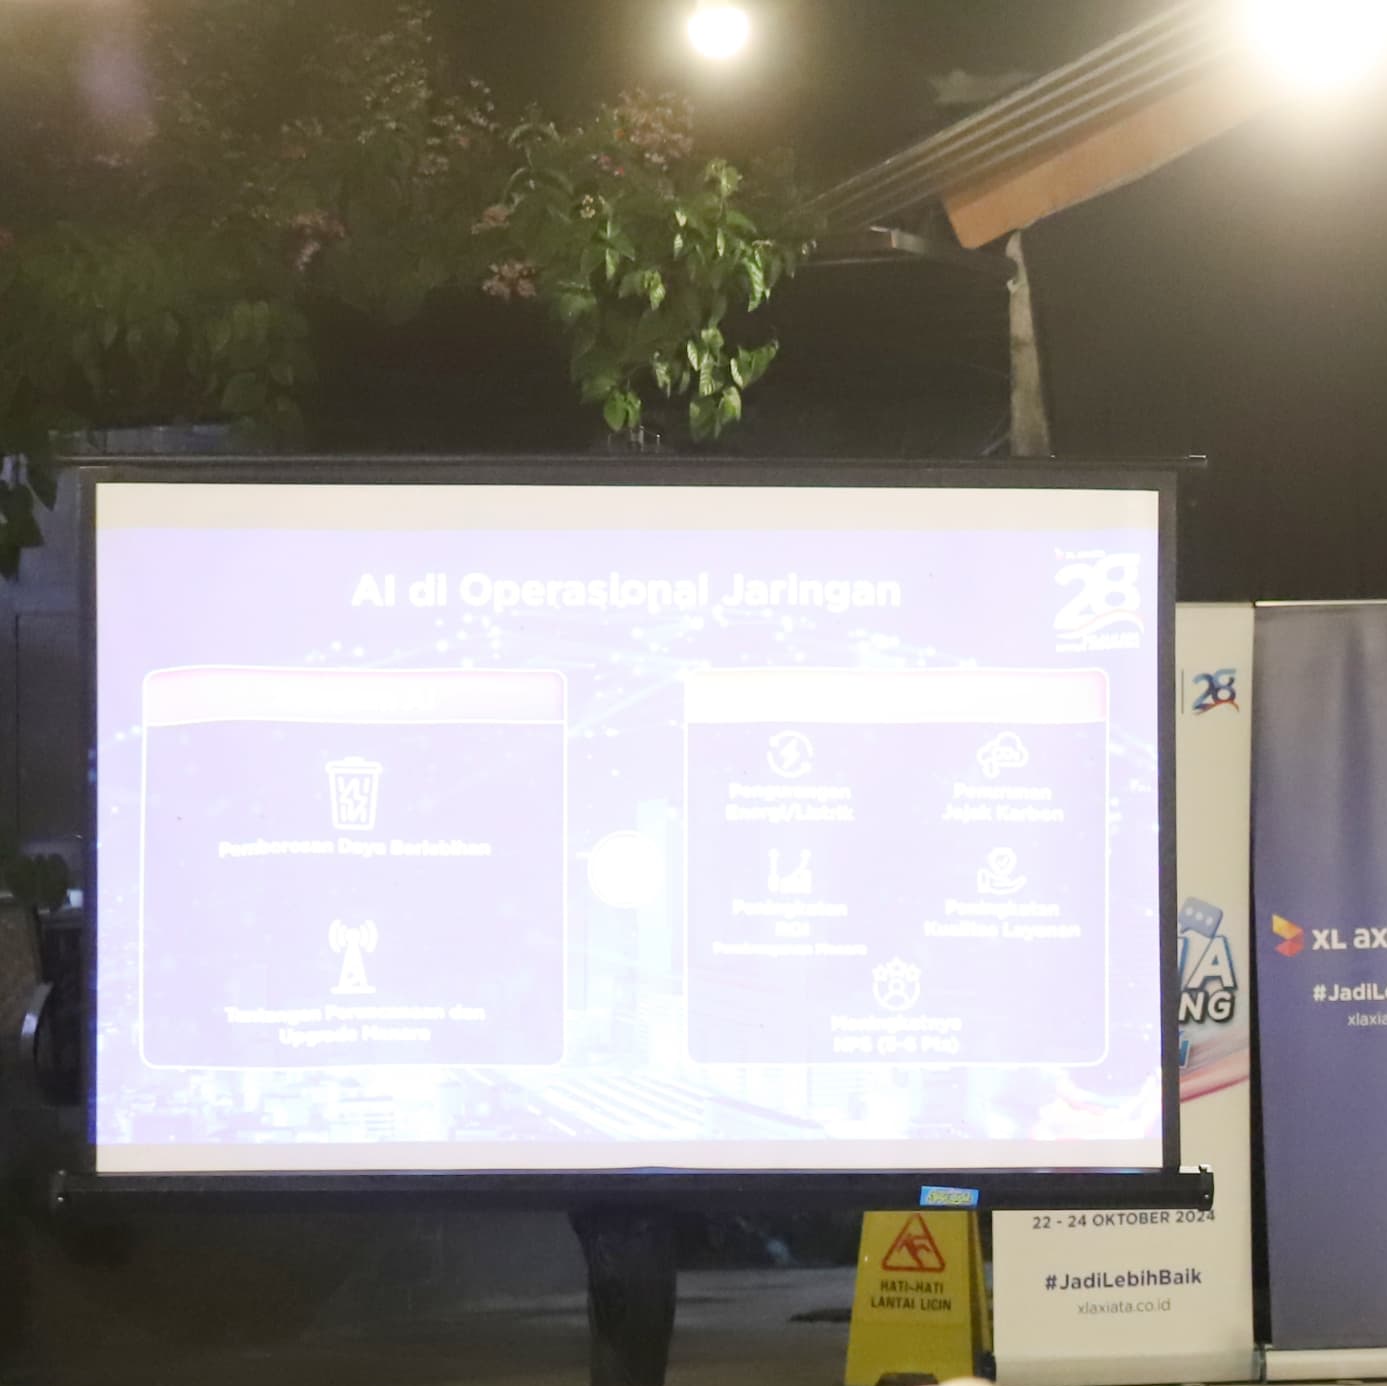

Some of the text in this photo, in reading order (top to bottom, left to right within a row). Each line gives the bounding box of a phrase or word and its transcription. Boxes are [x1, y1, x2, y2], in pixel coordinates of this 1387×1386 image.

[351, 571, 902, 613] AI di Operasional Jaringan
[1311, 928, 1348, 951] XL
[1032, 1215, 1052, 1230] 22
[1067, 1214, 1087, 1228] 24
[1092, 1211, 1170, 1228] OKTOBER
[1175, 1210, 1216, 1224] 2024
[880, 1280, 944, 1295] HATI-HATI
[1044, 1268, 1203, 1291] #JadiLebihBaik
[871, 1296, 952, 1312] LANTAI LICIN
[1077, 1298, 1172, 1315] xlaxiata.co.id
